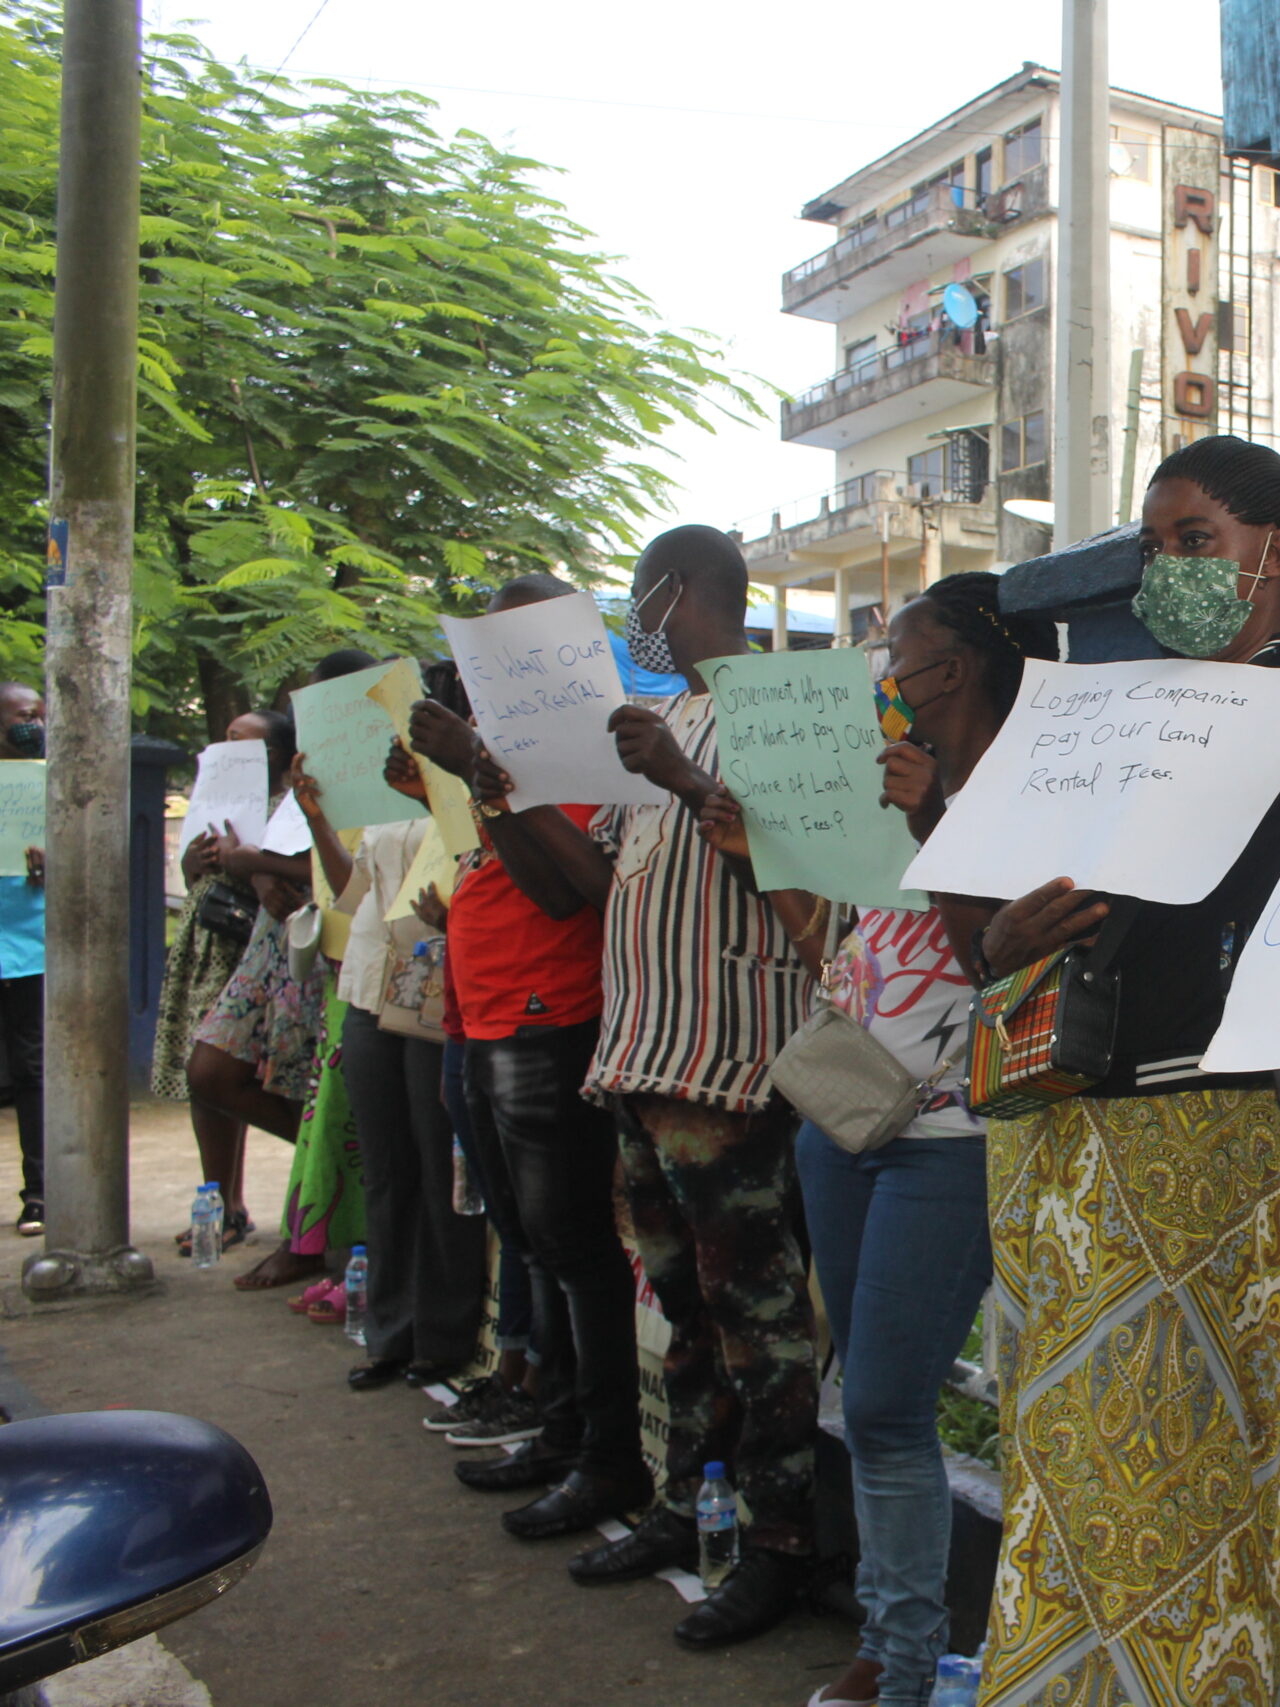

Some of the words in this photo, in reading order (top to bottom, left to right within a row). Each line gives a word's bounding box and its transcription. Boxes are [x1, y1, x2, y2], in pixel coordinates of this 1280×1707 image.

[1173, 184, 1215, 449] RIVO
[494, 645, 549, 679] WANT
[827, 682, 850, 711] you
[1029, 678, 1114, 720] Logging
[1125, 680, 1249, 708] Companies
[790, 721, 807, 744] to
[1158, 719, 1214, 749] Land
[729, 759, 783, 799] Share
[810, 759, 854, 795] Land
[1020, 761, 1103, 796] Rental
